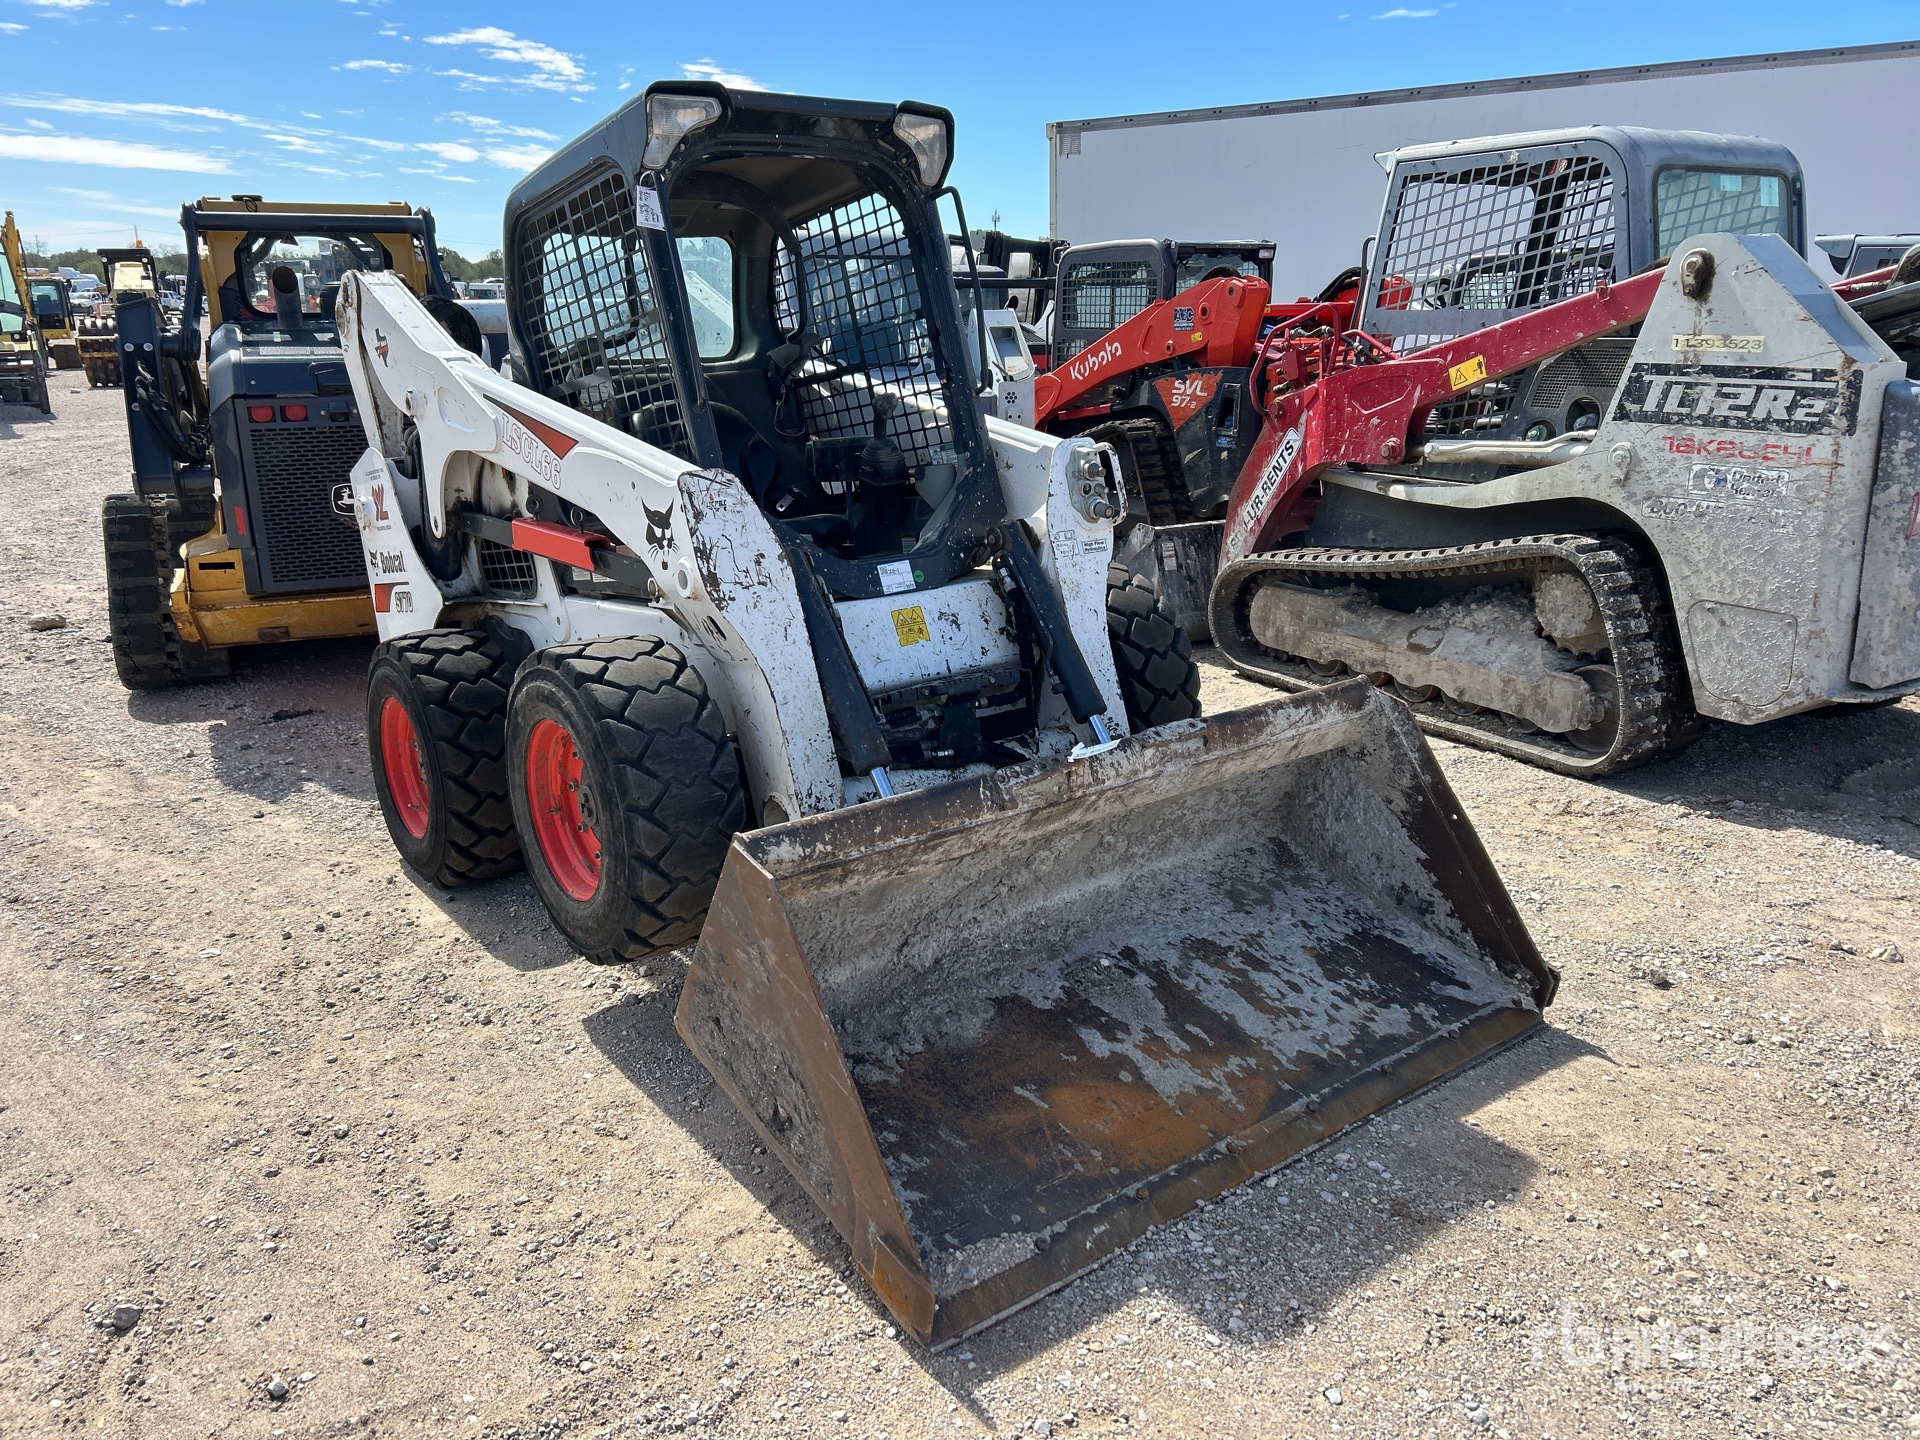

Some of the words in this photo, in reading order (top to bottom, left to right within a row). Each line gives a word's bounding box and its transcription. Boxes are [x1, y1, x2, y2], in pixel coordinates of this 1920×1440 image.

[1674, 338, 1762, 350] 11393523
[1070, 341, 1122, 380] Kubota
[1172, 379, 1207, 397] SVL
[1171, 395, 1197, 409] 97-2
[502, 412, 561, 490] LSCL66
[379, 550, 407, 574] Bobcat
